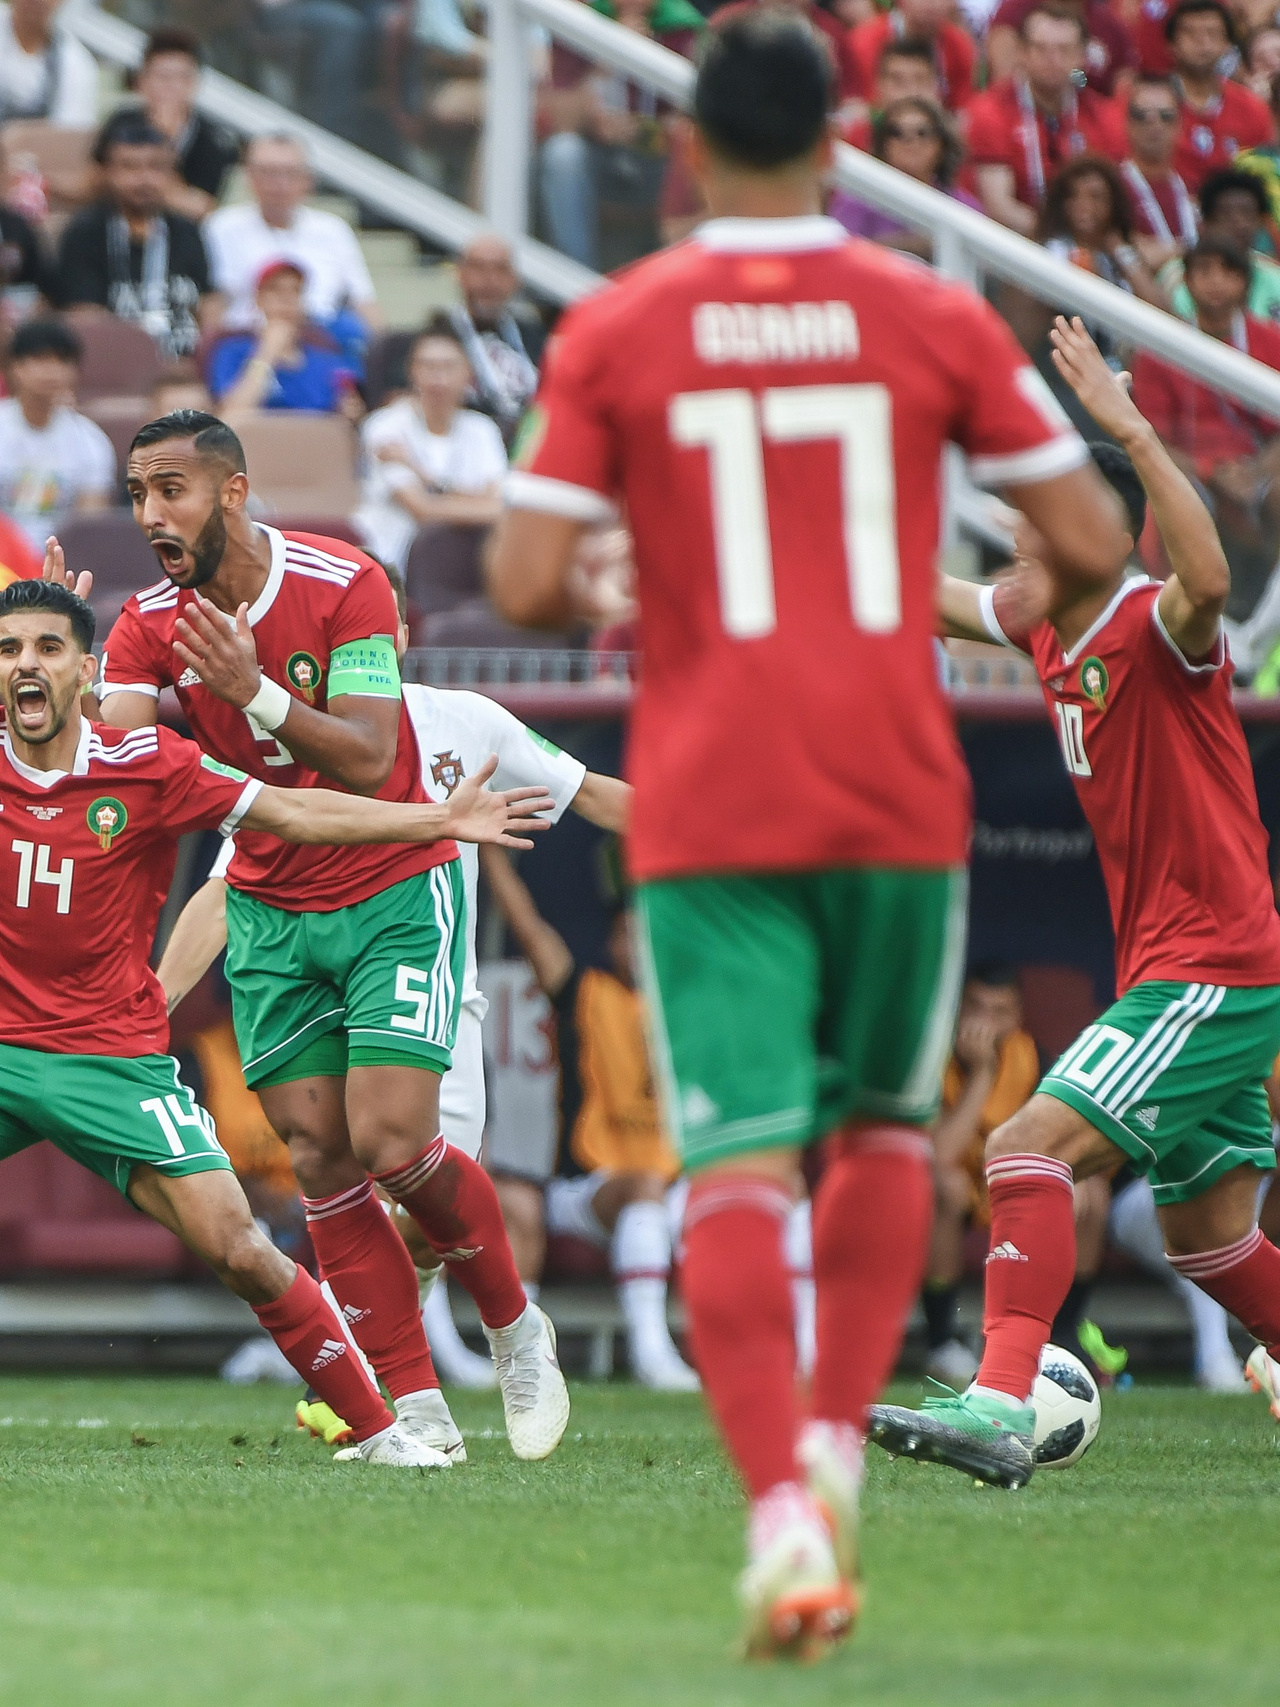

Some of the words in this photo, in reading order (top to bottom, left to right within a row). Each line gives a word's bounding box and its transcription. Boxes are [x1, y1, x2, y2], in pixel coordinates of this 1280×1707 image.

[668, 382, 903, 641] 17
[368, 675, 392, 685] FIFA
[1054, 700, 1093, 777] 10
[12, 838, 75, 915] 14
[390, 964, 429, 1033] 5
[1051, 1023, 1136, 1091] 10
[139, 1093, 220, 1157] 14
